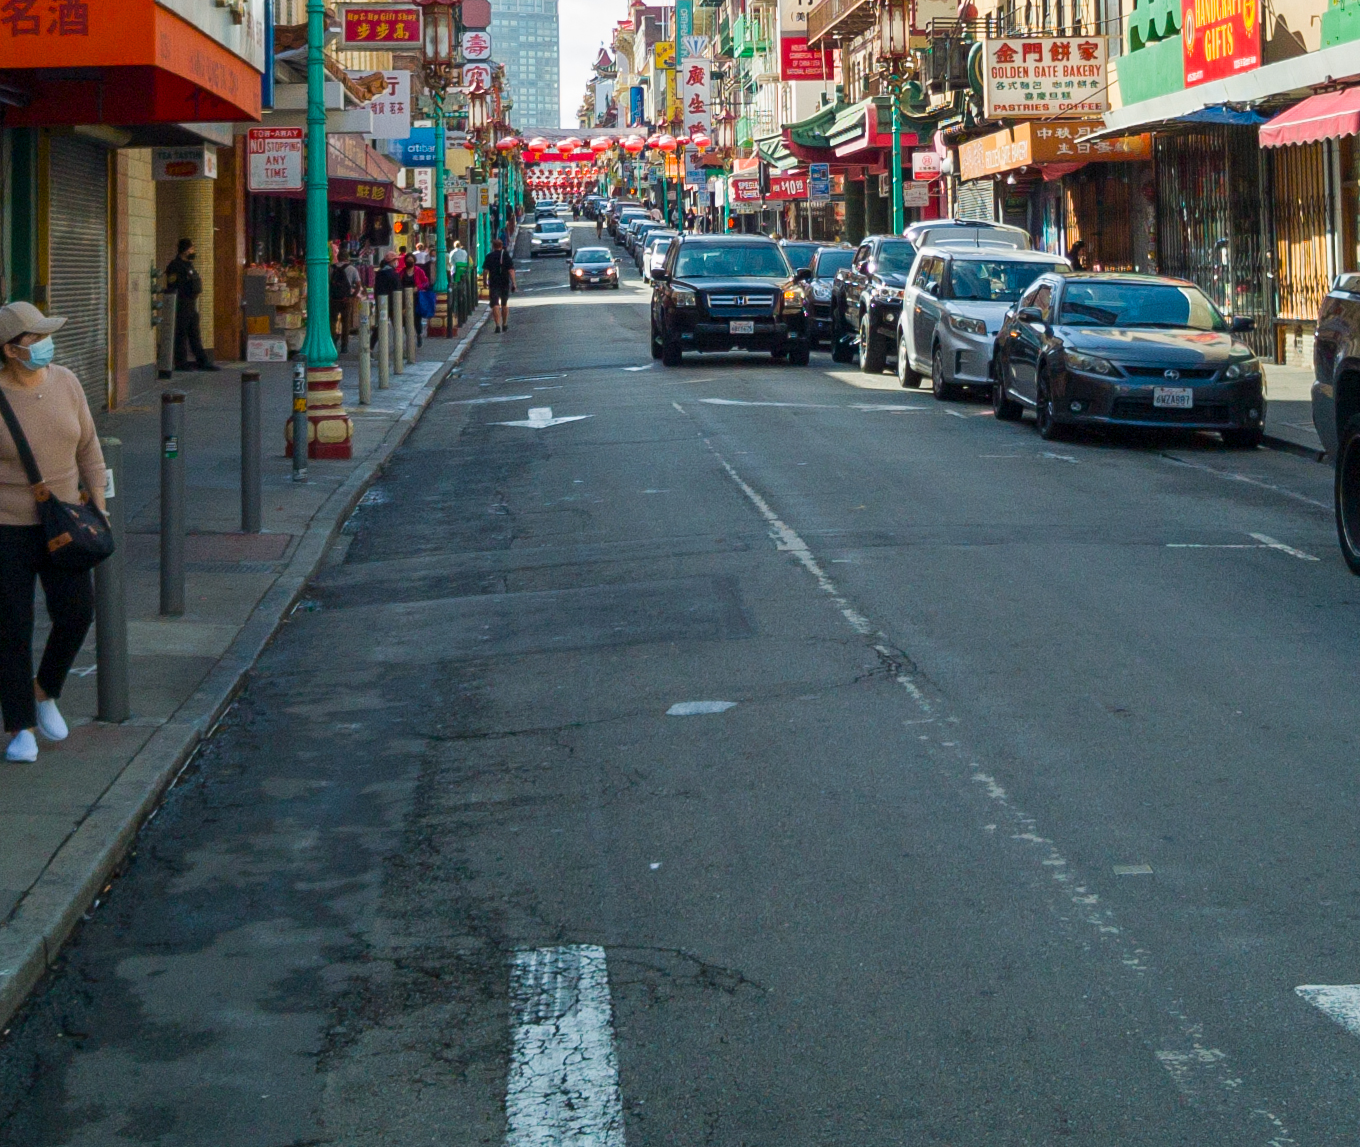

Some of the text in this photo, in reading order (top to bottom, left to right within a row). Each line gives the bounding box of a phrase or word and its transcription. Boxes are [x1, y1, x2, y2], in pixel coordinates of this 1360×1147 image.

[355, 22, 410, 40] 步步高
[1204, 22, 1234, 62] GIFTS
[993, 41, 1099, 64] 金門餅家
[991, 64, 1102, 79] GOLDEN GATE BAKERY
[993, 102, 1102, 112] PASTRIES COFFEE
[253, 130, 299, 138] TOW-AWAY
[250, 138, 301, 153] NO STOPPING
[265, 155, 287, 166] ANY
[264, 167, 289, 179] TIME
